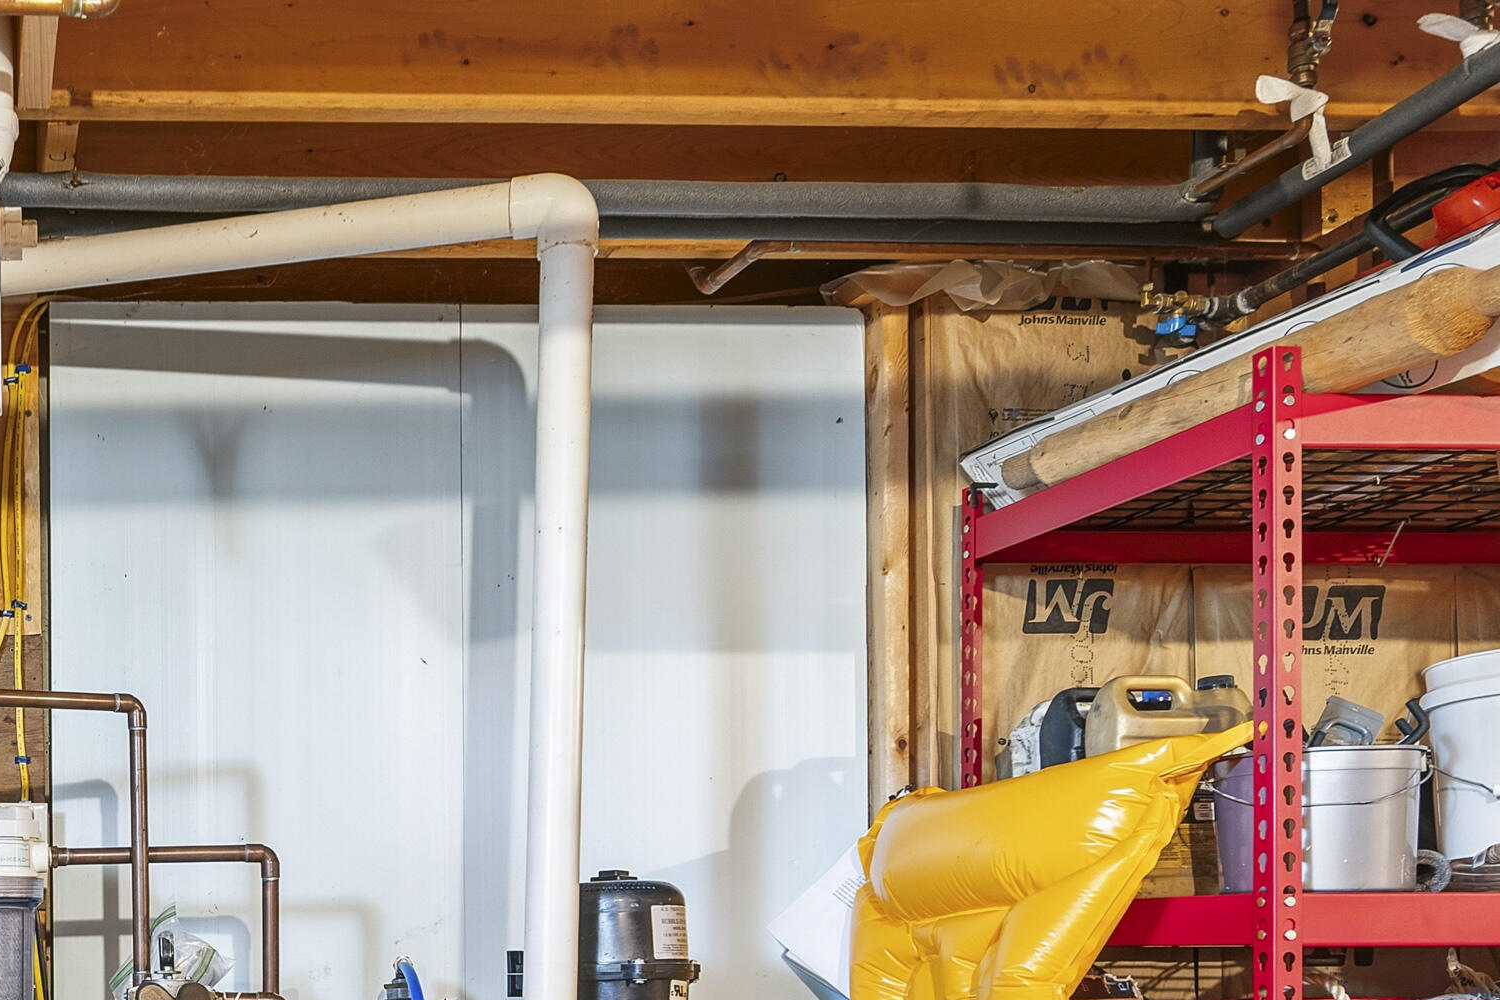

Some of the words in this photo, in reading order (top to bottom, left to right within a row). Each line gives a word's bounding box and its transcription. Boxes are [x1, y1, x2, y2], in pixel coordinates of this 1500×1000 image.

[1018, 315, 1056, 326] Johns
[1057, 315, 1106, 325] Manville
[1301, 645, 1321, 655] hns
[1323, 645, 1375, 655] Manville
